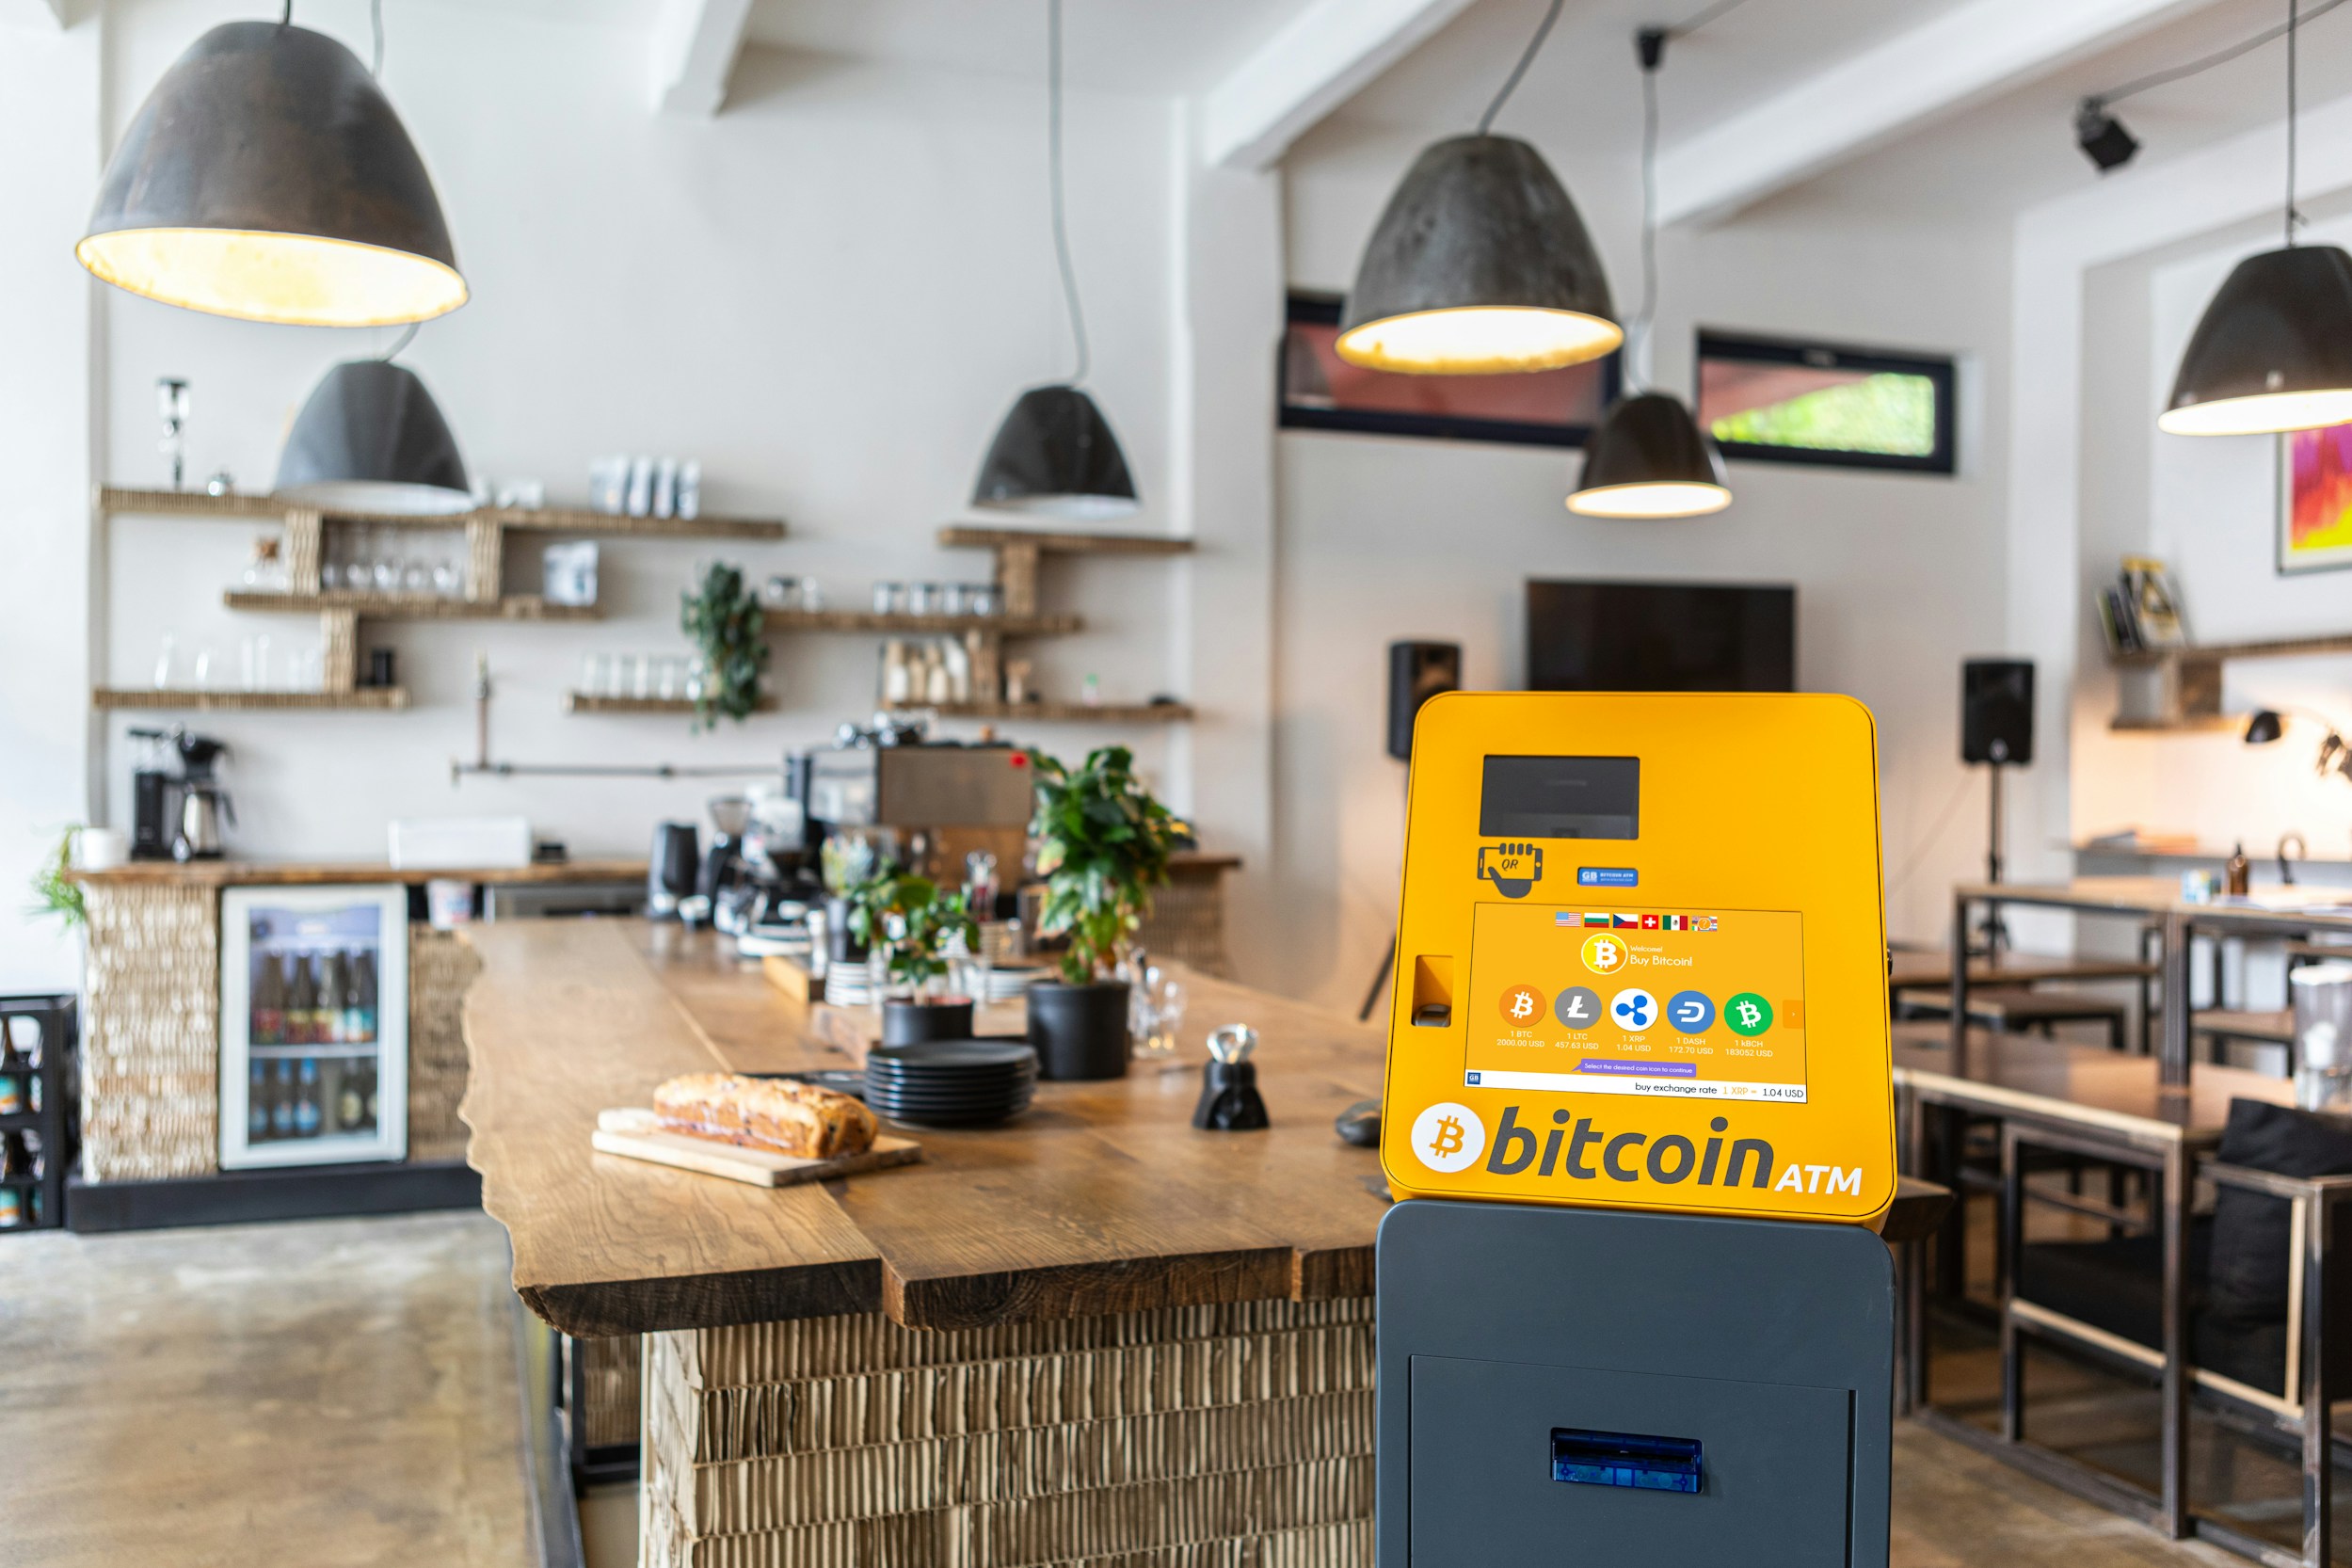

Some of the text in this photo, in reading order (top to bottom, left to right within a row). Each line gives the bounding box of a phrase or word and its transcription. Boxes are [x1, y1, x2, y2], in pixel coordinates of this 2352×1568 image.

[1501, 858, 1518, 871] QR
[1630, 955, 1692, 967] Buy Bitcoin!
[1669, 1046, 1694, 1054] 172.70
[1635, 1082, 1652, 1092] buy
[1653, 1084, 1697, 1094] exchange
[1722, 1086, 1727, 1095] 1
[1762, 1088, 1782, 1096] 1.04
[1784, 1089, 1804, 1098] USD
[1486, 1106, 1863, 1196] bitcoin ATM
